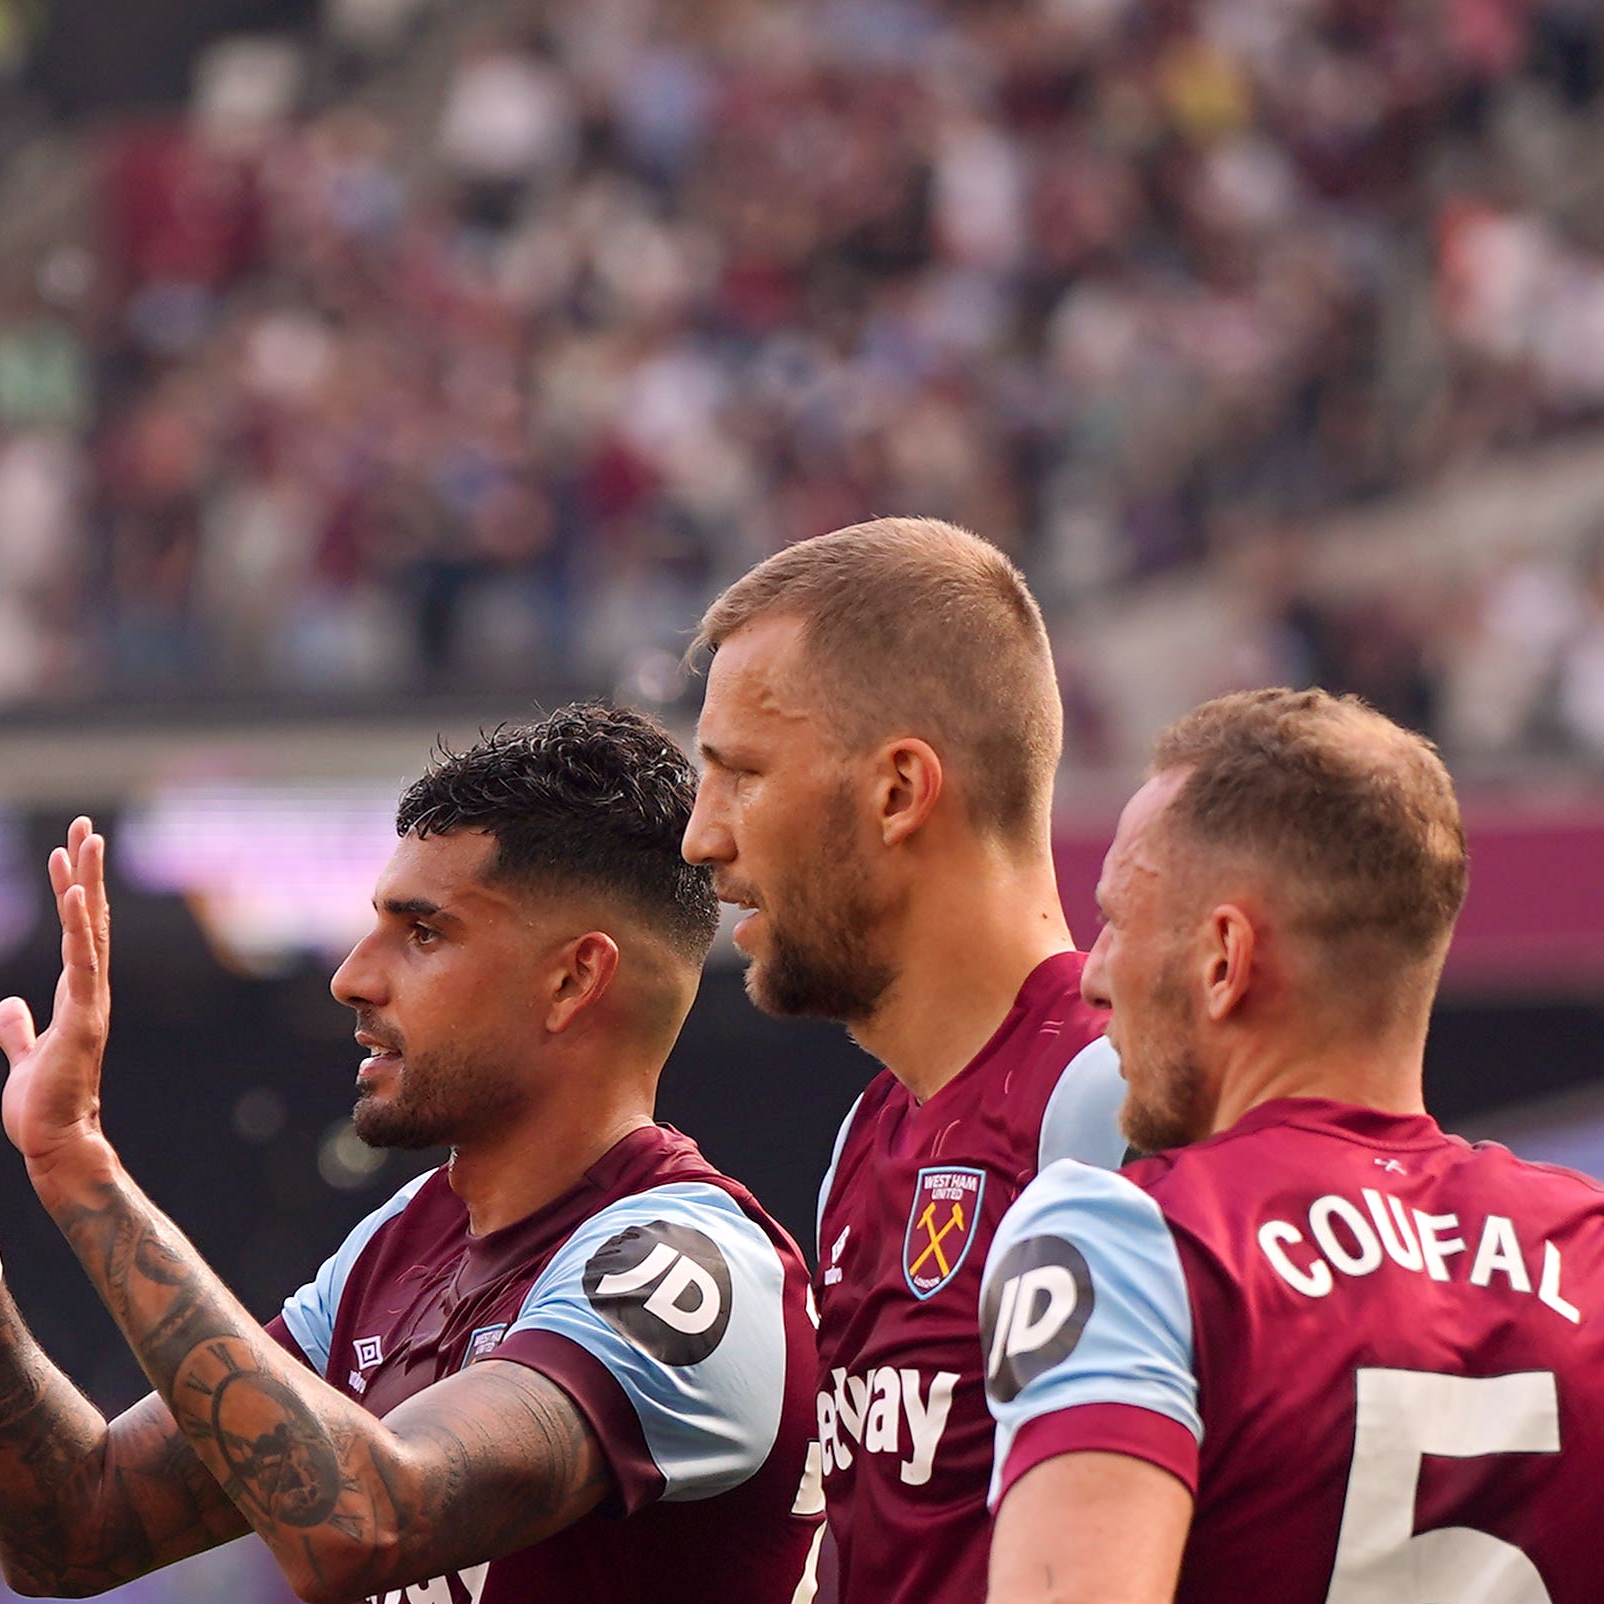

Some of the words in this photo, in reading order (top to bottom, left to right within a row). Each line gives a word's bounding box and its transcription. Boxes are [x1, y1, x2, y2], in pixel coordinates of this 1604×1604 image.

[924, 1174, 950, 1189] WEST
[953, 1174, 978, 1192] HAM
[931, 1187, 964, 1200] UNITED
[595, 1242, 721, 1335] JD
[1259, 1188, 1580, 1324] COUFAL
[988, 1265, 1078, 1379] JD
